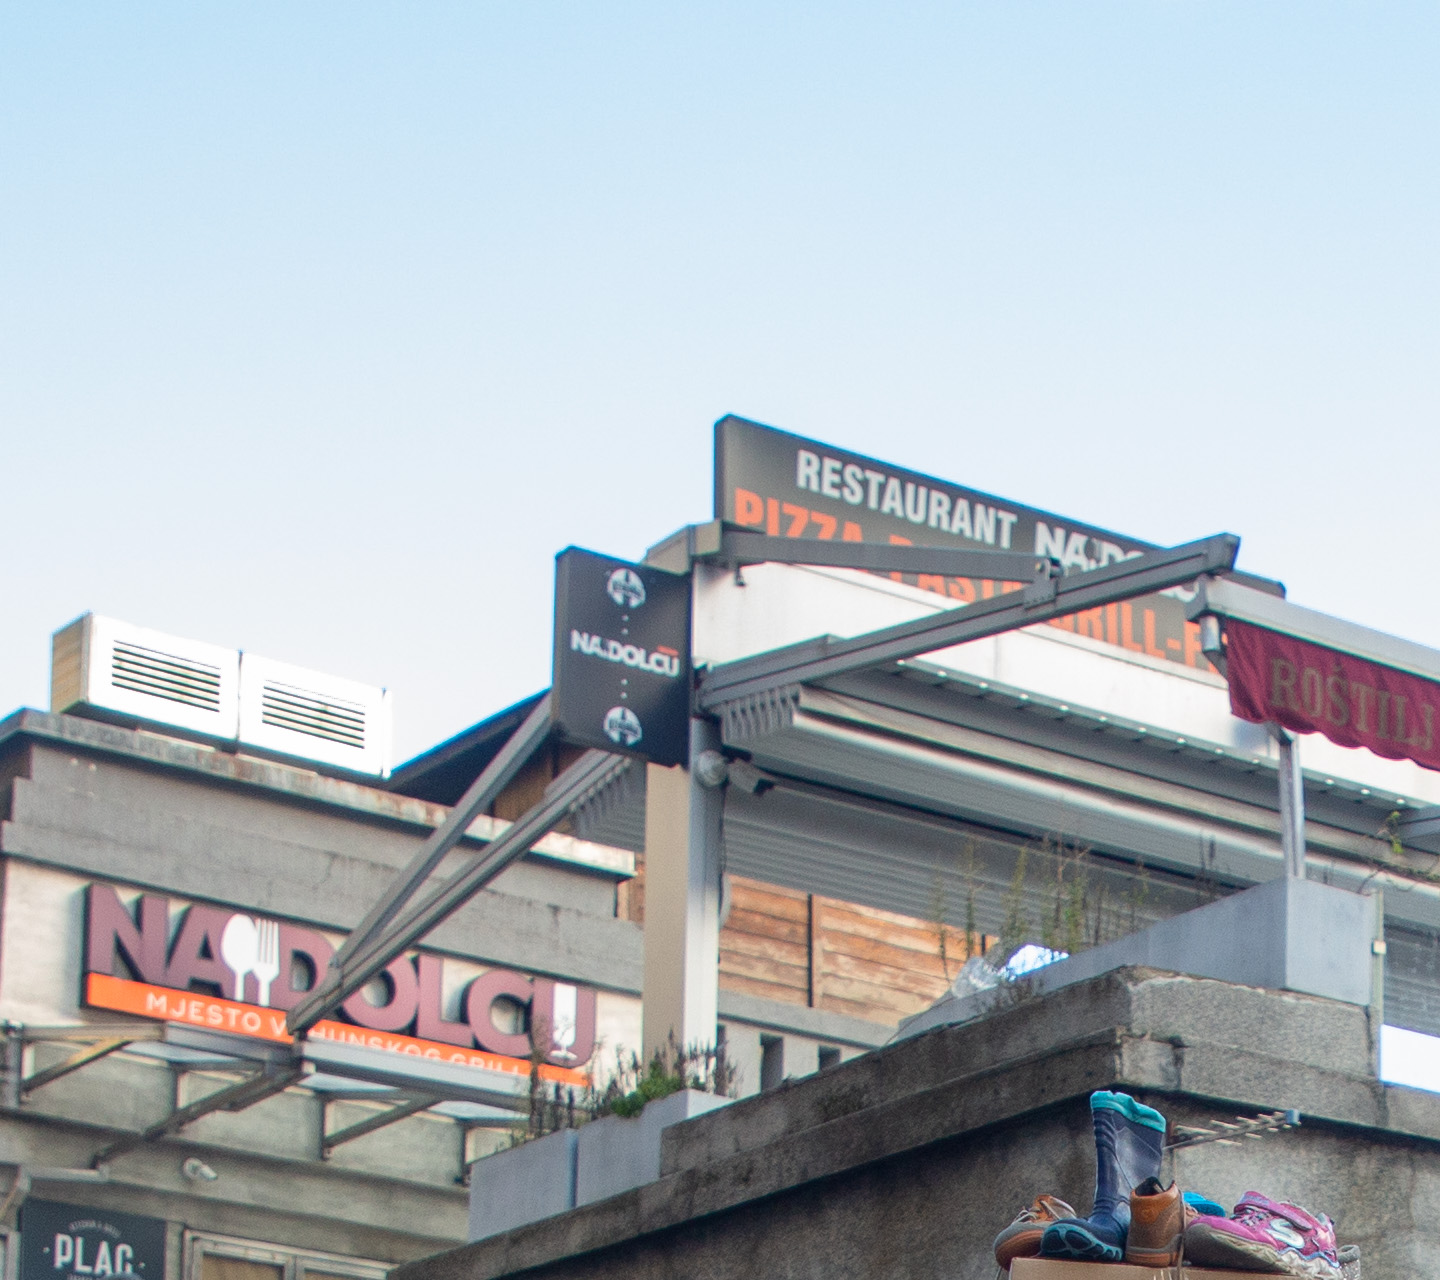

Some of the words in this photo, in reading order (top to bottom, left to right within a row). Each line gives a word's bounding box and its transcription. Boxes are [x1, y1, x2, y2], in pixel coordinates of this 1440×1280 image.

[796, 449, 1018, 549] RESTAURANT
[1271, 655, 1436, 752] ROŠTILJ
[146, 992, 262, 1032] MJESTO
[270, 1016, 441, 1062] VHUNSKOG
[54, 1233, 134, 1276] PLAC
